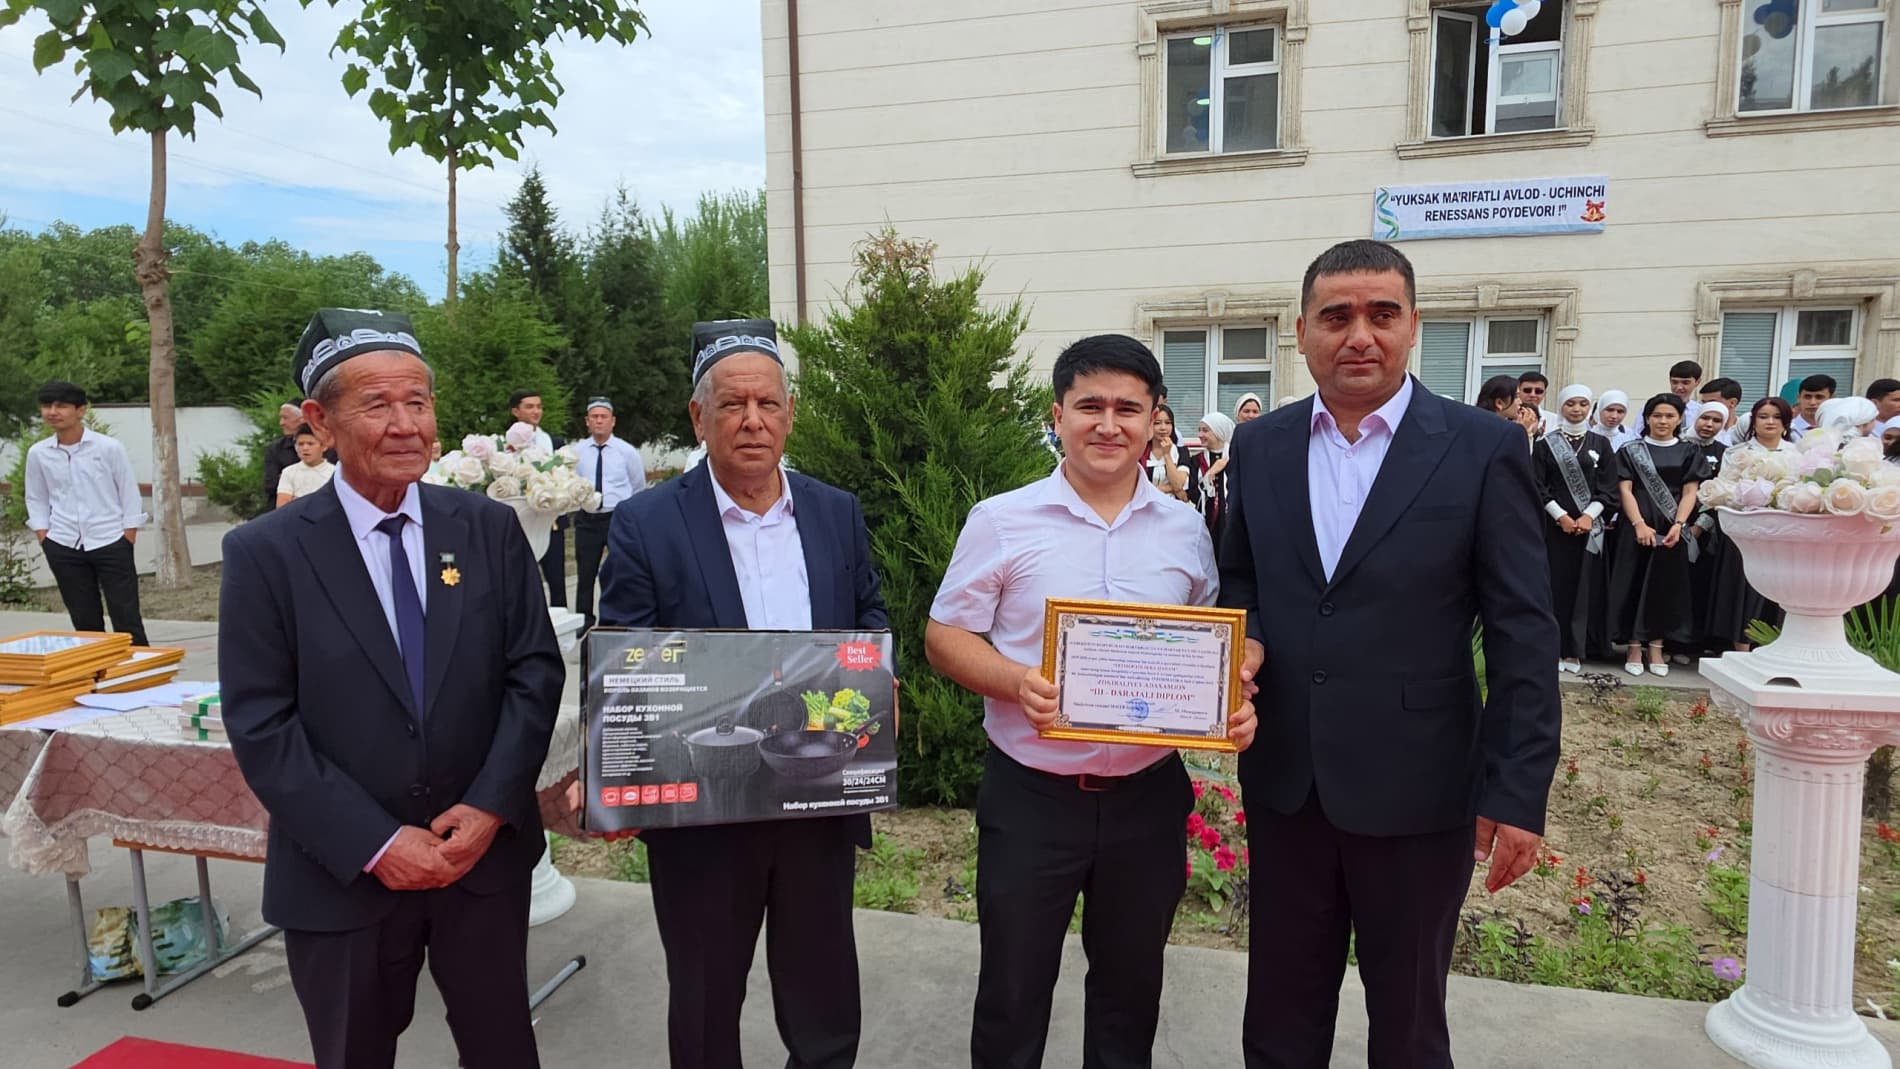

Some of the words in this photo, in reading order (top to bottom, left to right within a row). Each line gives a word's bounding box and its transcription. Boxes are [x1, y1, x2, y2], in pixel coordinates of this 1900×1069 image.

[1503, 188, 1541, 201] AVLOD
[1549, 185, 1605, 199] UCHINCHI
[1424, 208, 1490, 222] RENESSANS
[1492, 205, 1556, 219] POYDEVORI
[847, 646, 866, 655] Best
[847, 655, 873, 664] Seller
[1111, 689, 1154, 699] DARAJALI
[602, 704, 634, 714] НАБОР
[635, 703, 684, 713] КУХОННОЙ
[602, 714, 643, 723] ПОСУДЫ
[783, 801, 808, 811] Набор
